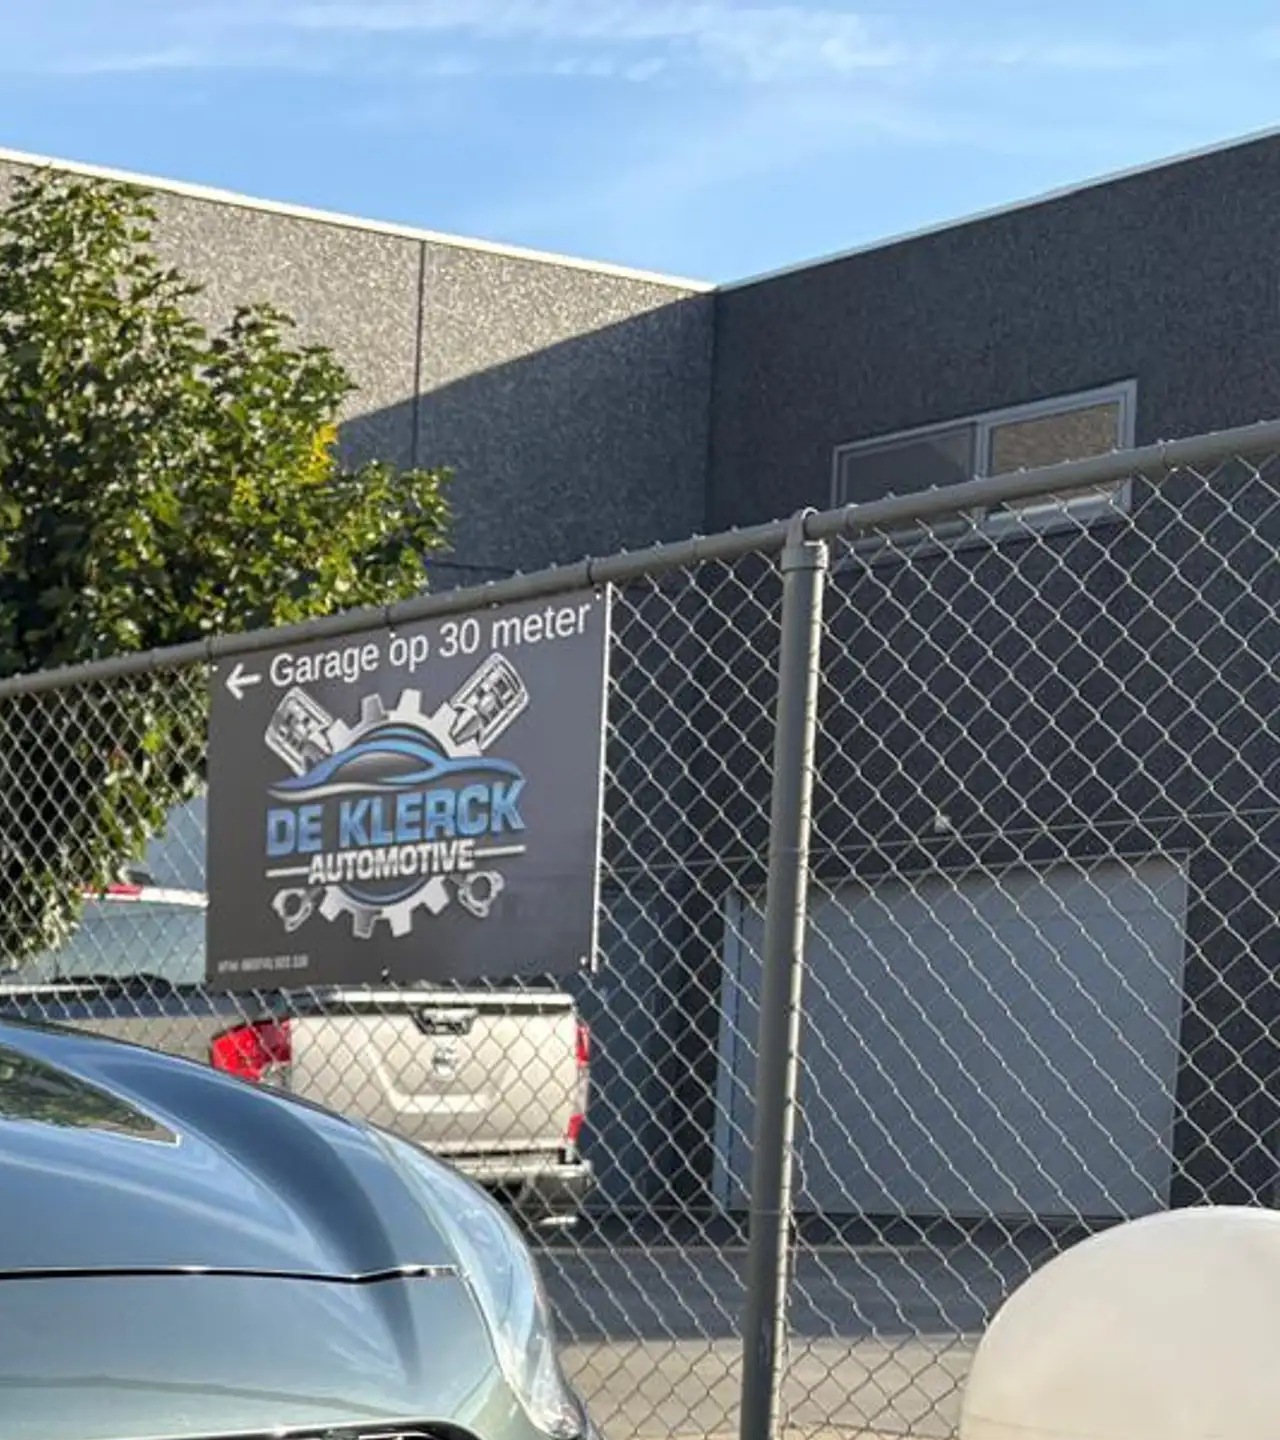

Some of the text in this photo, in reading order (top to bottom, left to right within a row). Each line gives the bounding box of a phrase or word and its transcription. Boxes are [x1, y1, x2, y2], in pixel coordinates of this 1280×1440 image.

[269, 602, 591, 687] Garage op 30 meter
[267, 779, 526, 855] DE KLERCK
[308, 839, 476, 885] AUTOMOTIVE
